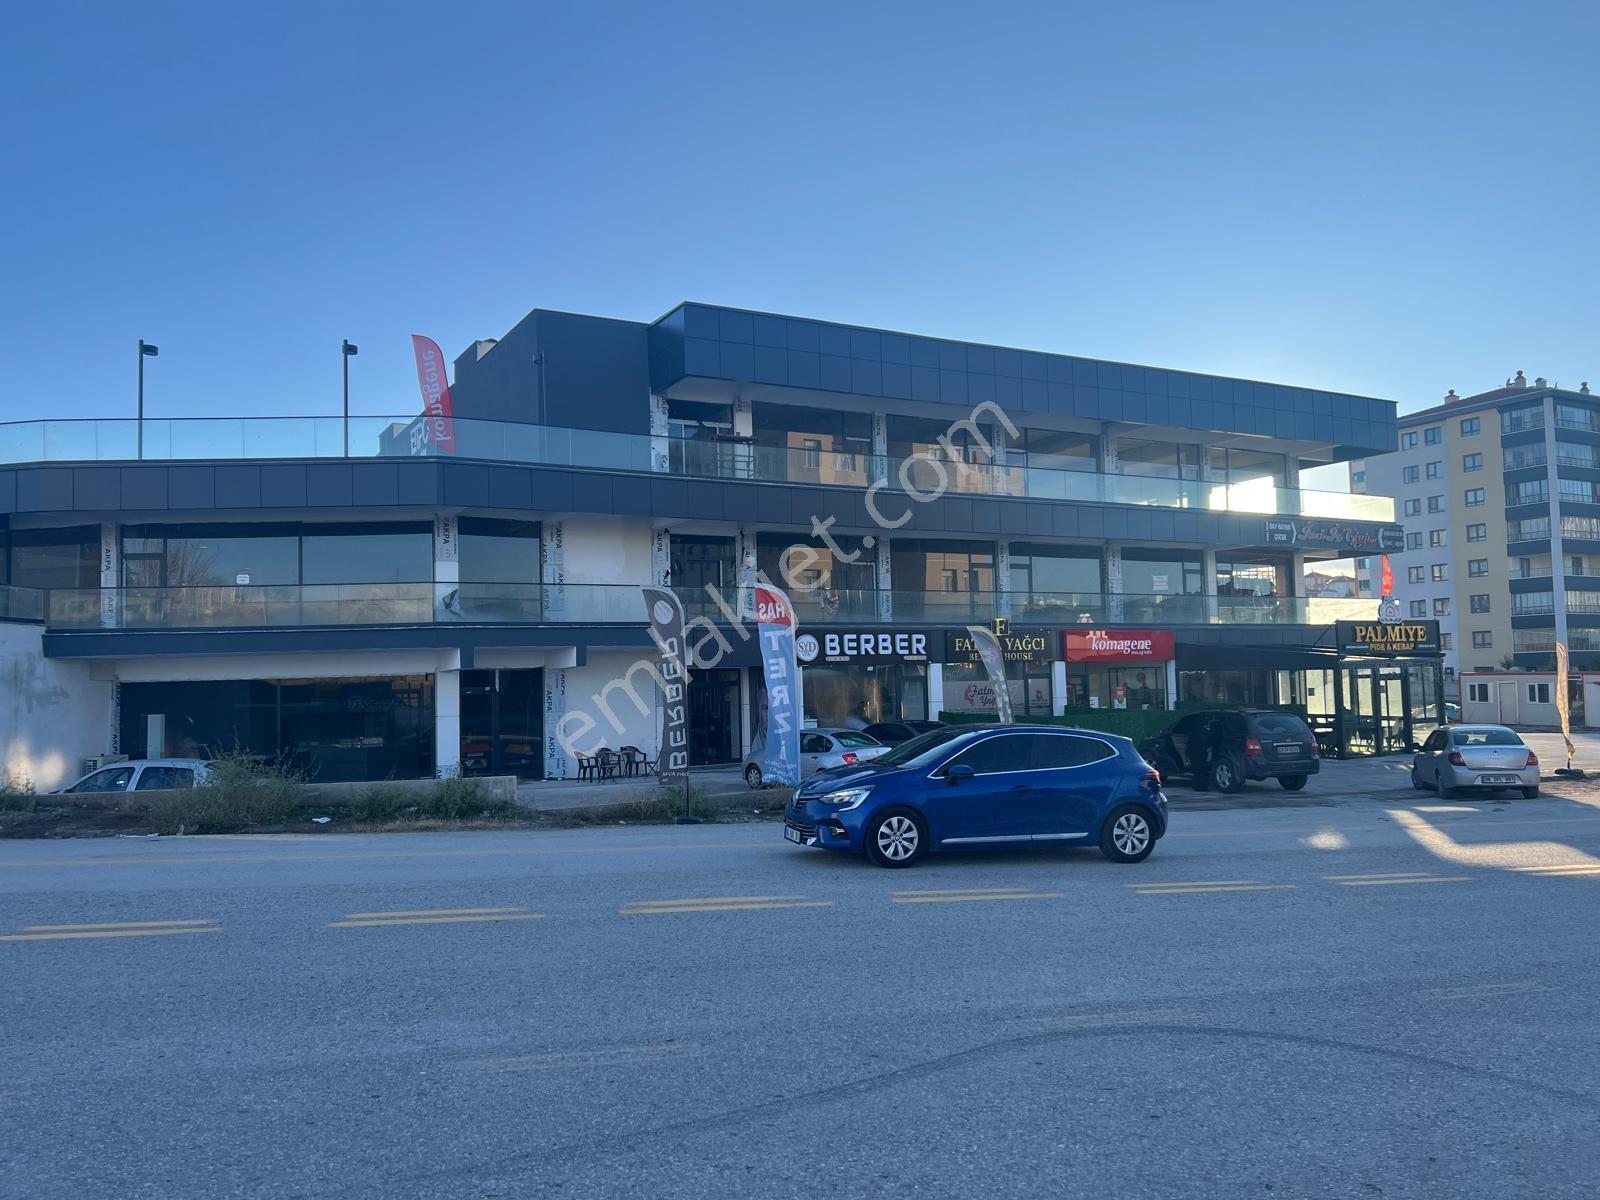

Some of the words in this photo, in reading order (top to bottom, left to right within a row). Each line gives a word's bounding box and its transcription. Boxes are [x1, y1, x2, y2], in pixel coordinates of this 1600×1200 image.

[442, 524, 450, 545] AKPA
[104, 548, 112, 571] AKPA
[1354, 622, 1428, 643] PALMİYE
[824, 633, 927, 656] BERBER
[1005, 635, 1045, 651] YAĞCI
[1091, 637, 1152, 655] komagene
[1004, 652, 1034, 661] HOUSE
[969, 683, 995, 698] Fatm
